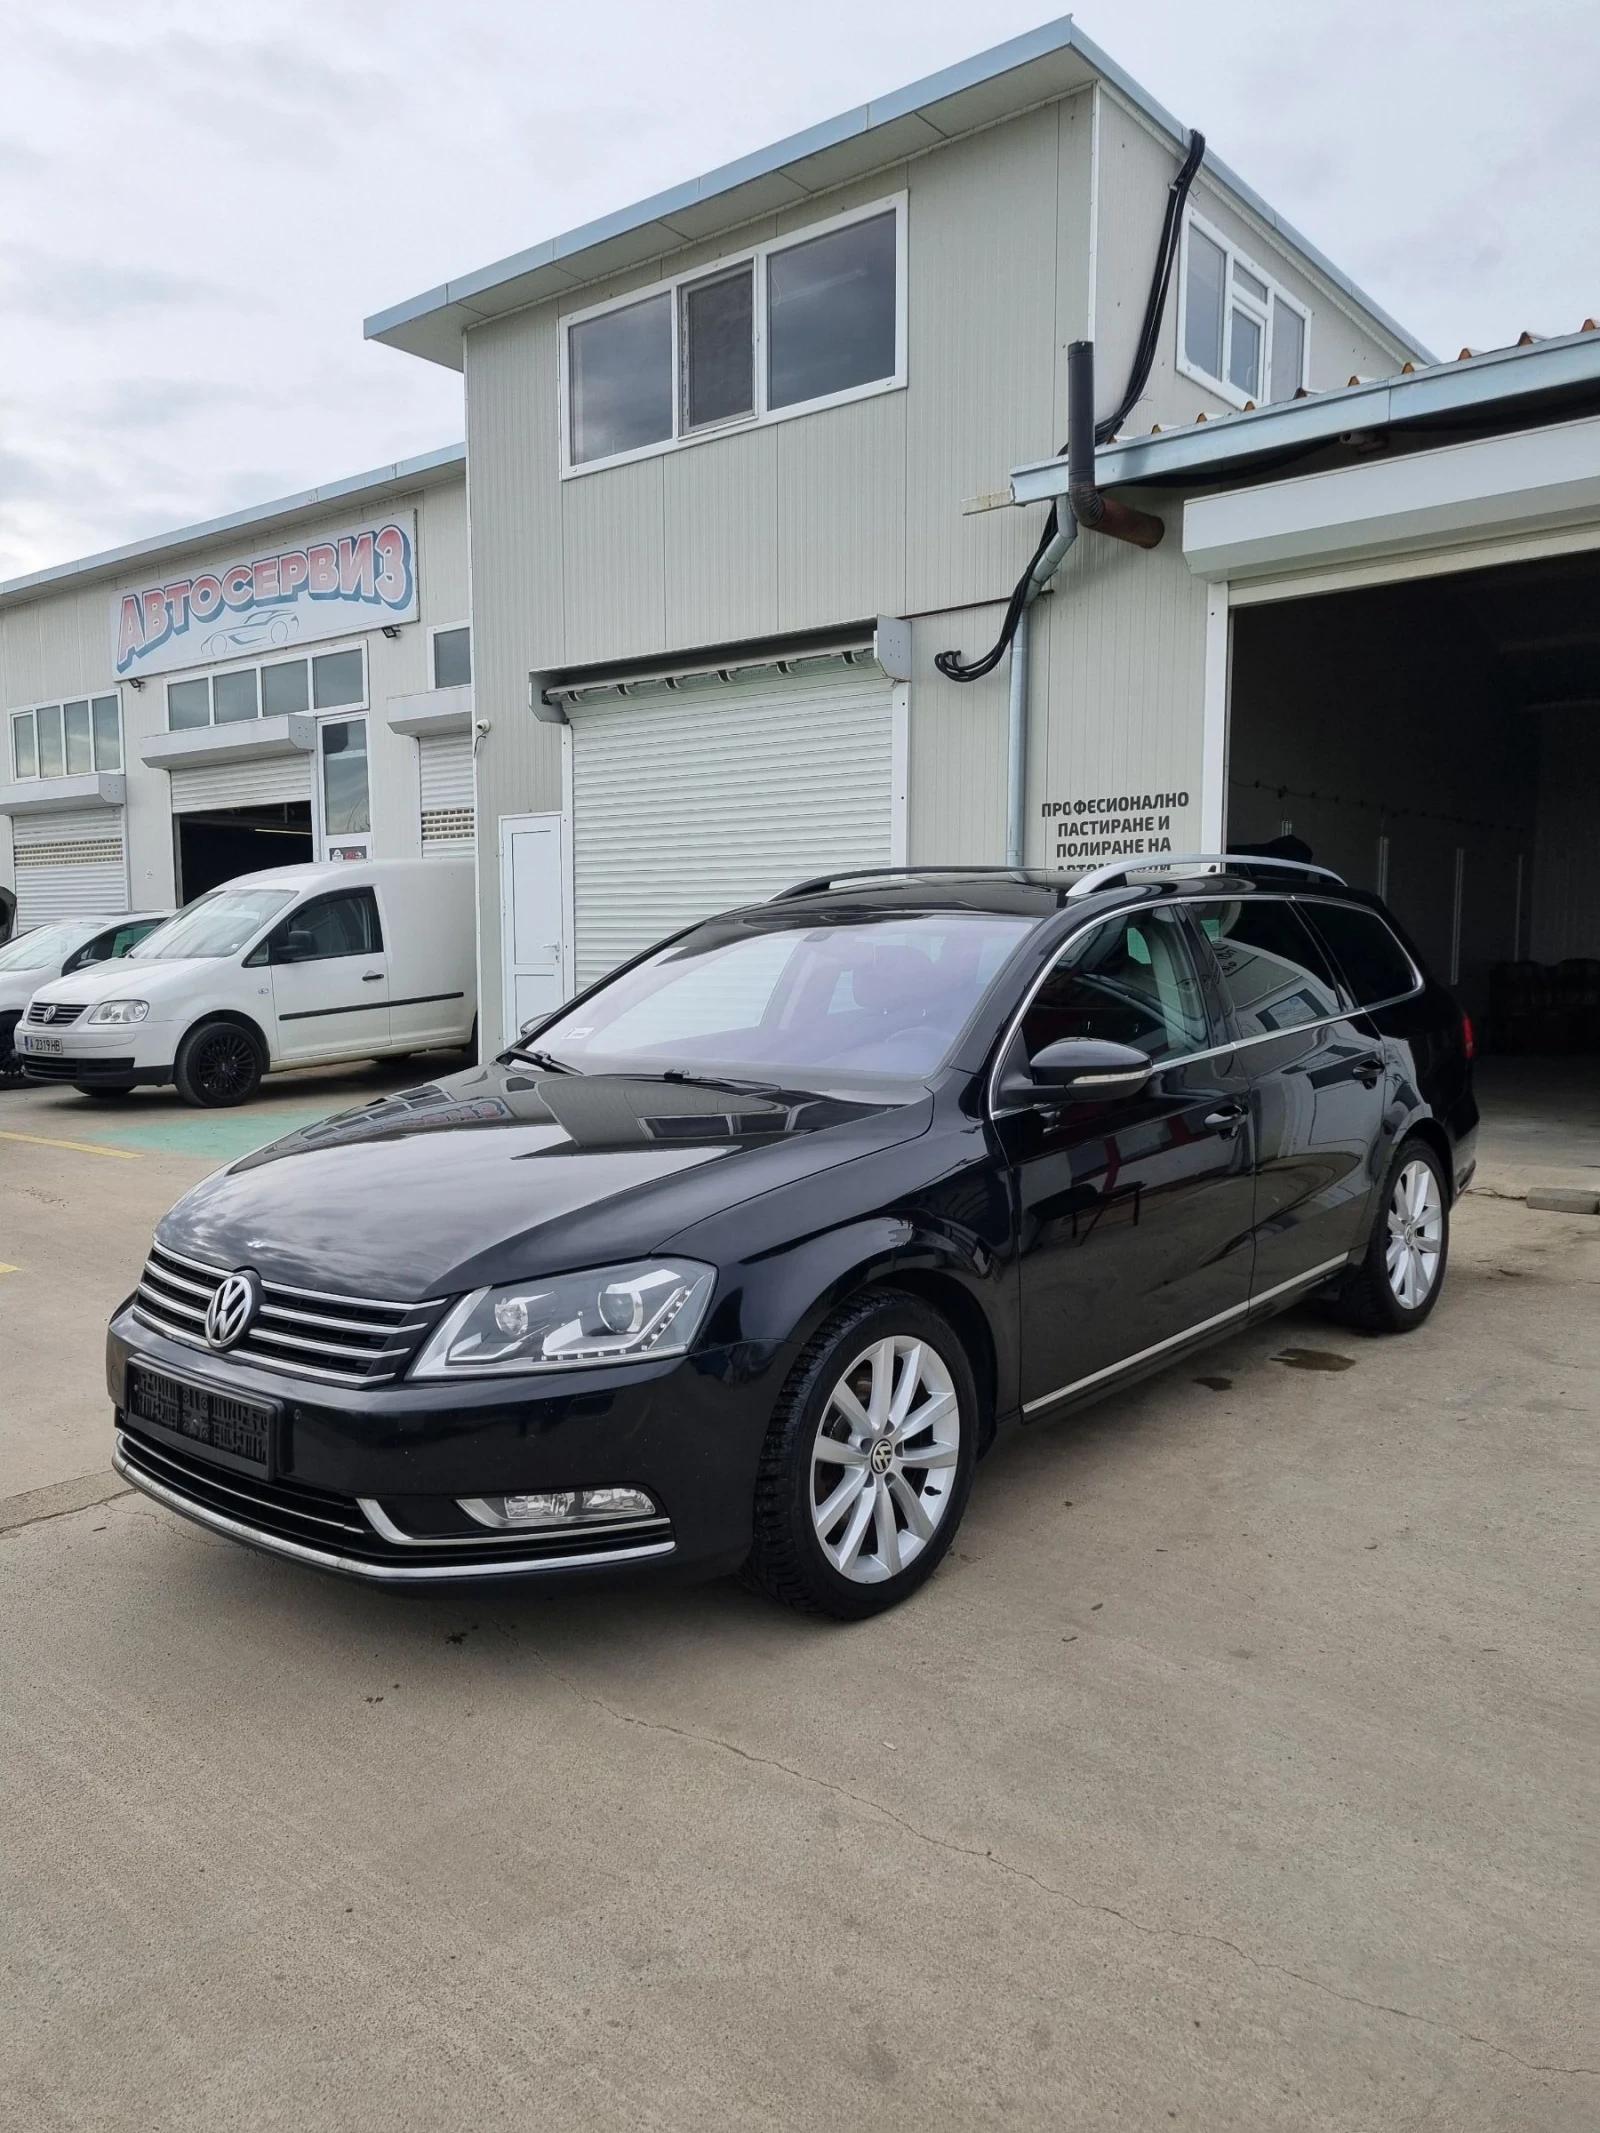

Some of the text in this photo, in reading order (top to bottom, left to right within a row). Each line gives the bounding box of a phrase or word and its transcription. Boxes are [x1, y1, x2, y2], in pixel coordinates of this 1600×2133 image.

[117, 525, 411, 673] АВТОСЕРВИЗ
[1041, 791, 1190, 818] ПРОФЕСИОНАЛНО
[1057, 815, 1171, 838] ПАСТИРАНЕ И
[1056, 836, 1172, 859] ПОЛИРАНЕ НА
[206, 1276, 252, 1346] VW
